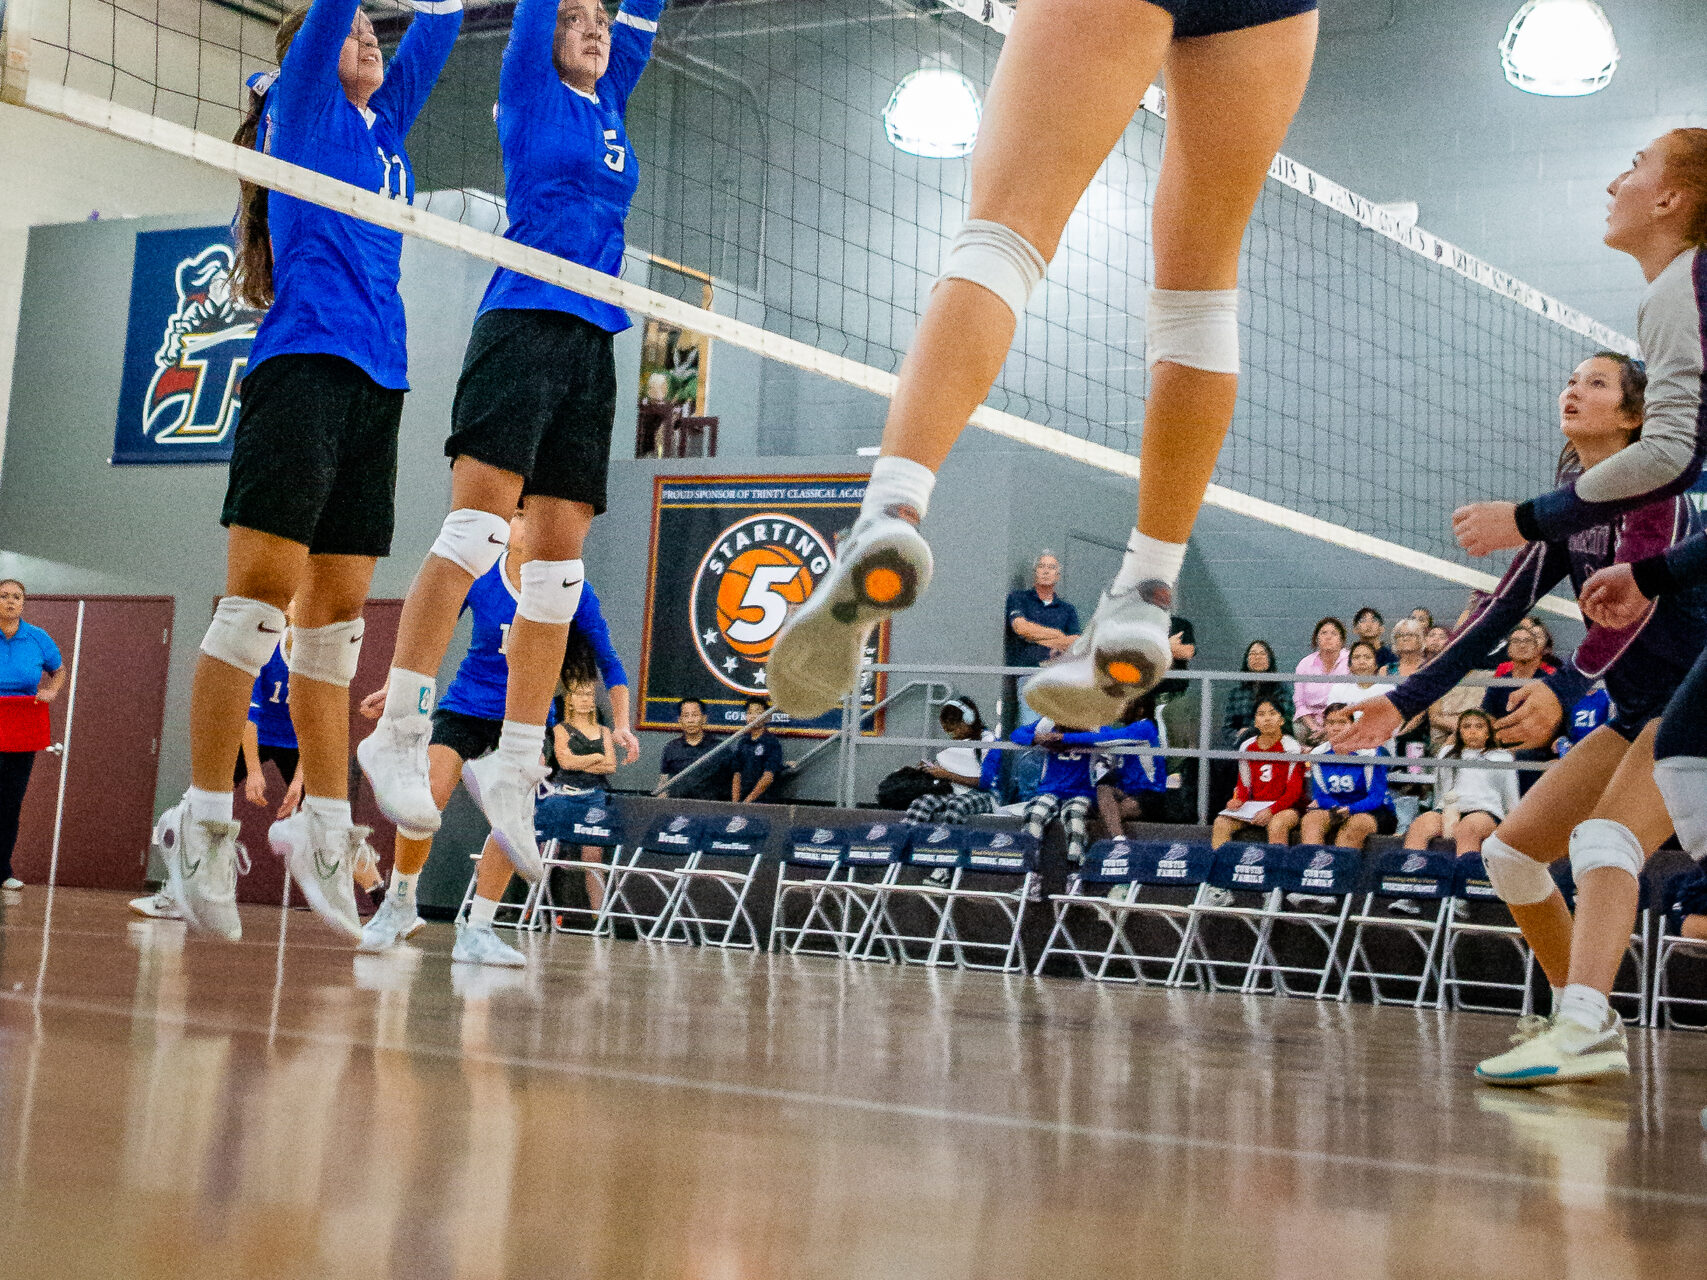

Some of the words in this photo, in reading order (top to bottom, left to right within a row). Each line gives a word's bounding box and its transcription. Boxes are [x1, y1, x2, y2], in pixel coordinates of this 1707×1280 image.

[602, 128, 626, 173] 5
[662, 489, 694, 500] PROUD
[695, 489, 736, 499] SPONSOR
[737, 489, 750, 498] OF
[787, 488, 836, 498] CLASSICAL
[709, 523, 829, 575] STARTING
[726, 564, 803, 644] 5
[725, 711, 739, 720] GO
[1574, 709, 1597, 728] 21
[1259, 764, 1273, 783] 3
